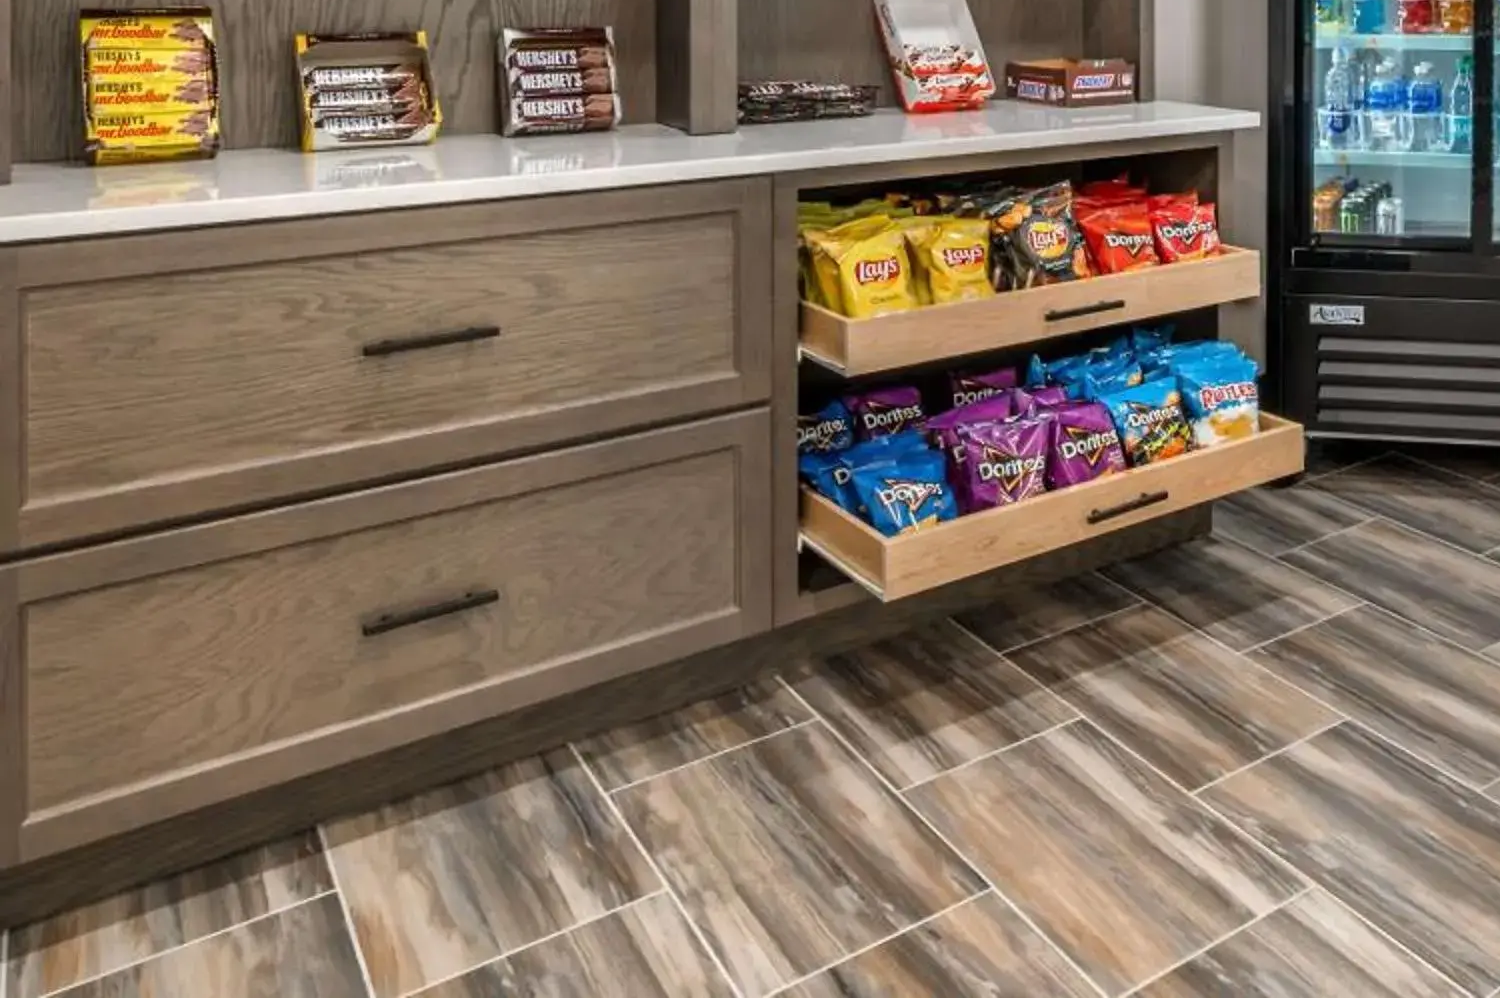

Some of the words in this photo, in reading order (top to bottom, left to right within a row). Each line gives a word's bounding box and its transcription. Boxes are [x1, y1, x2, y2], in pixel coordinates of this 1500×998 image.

[864, 404, 922, 430] Doritos
[1129, 406, 1179, 427] Doritos
[1061, 429, 1118, 459] Doritos
[979, 455, 1045, 481] Doritos
